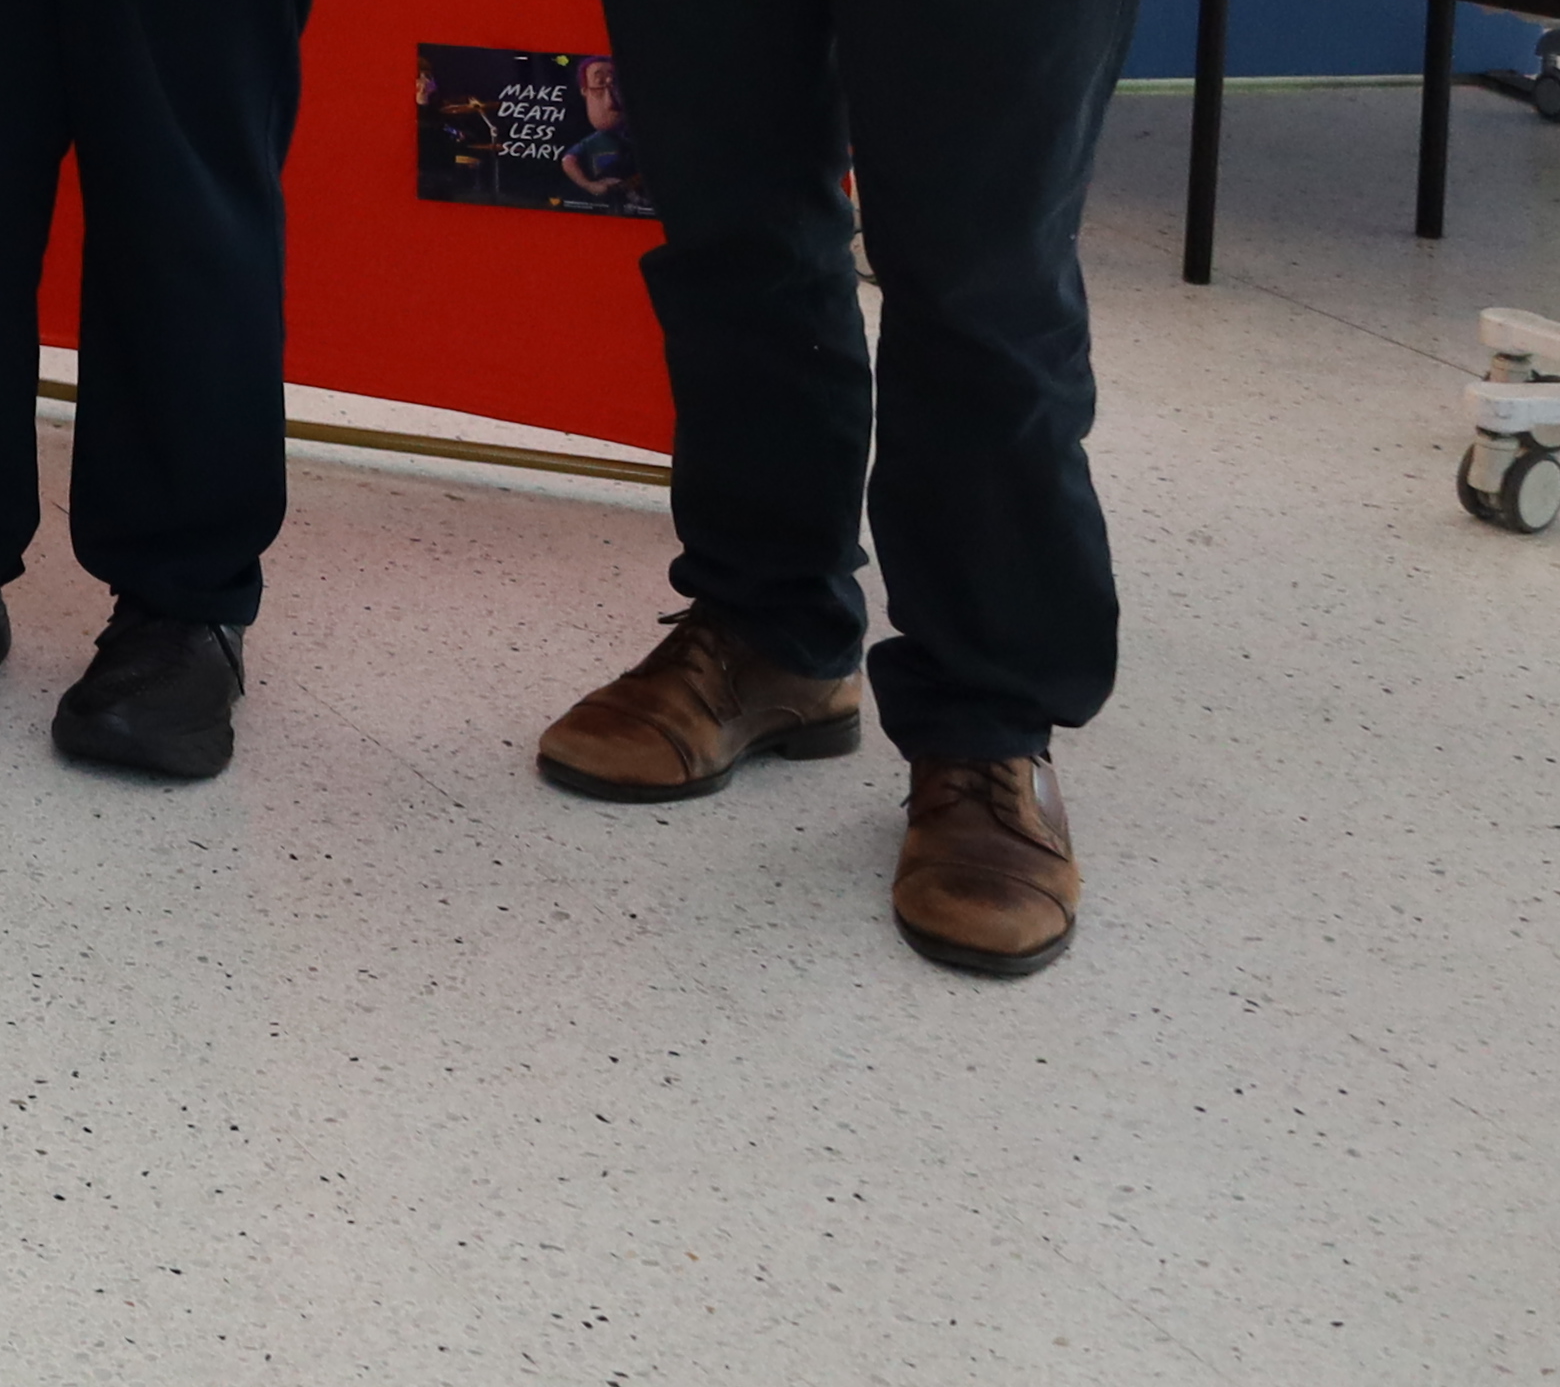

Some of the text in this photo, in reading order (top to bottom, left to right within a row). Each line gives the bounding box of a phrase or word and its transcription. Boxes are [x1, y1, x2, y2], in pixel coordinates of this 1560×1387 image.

[498, 83, 567, 102] MAKE
[497, 101, 566, 122] DEATH
[509, 123, 556, 140] LESS
[498, 141, 565, 161] SCARY
